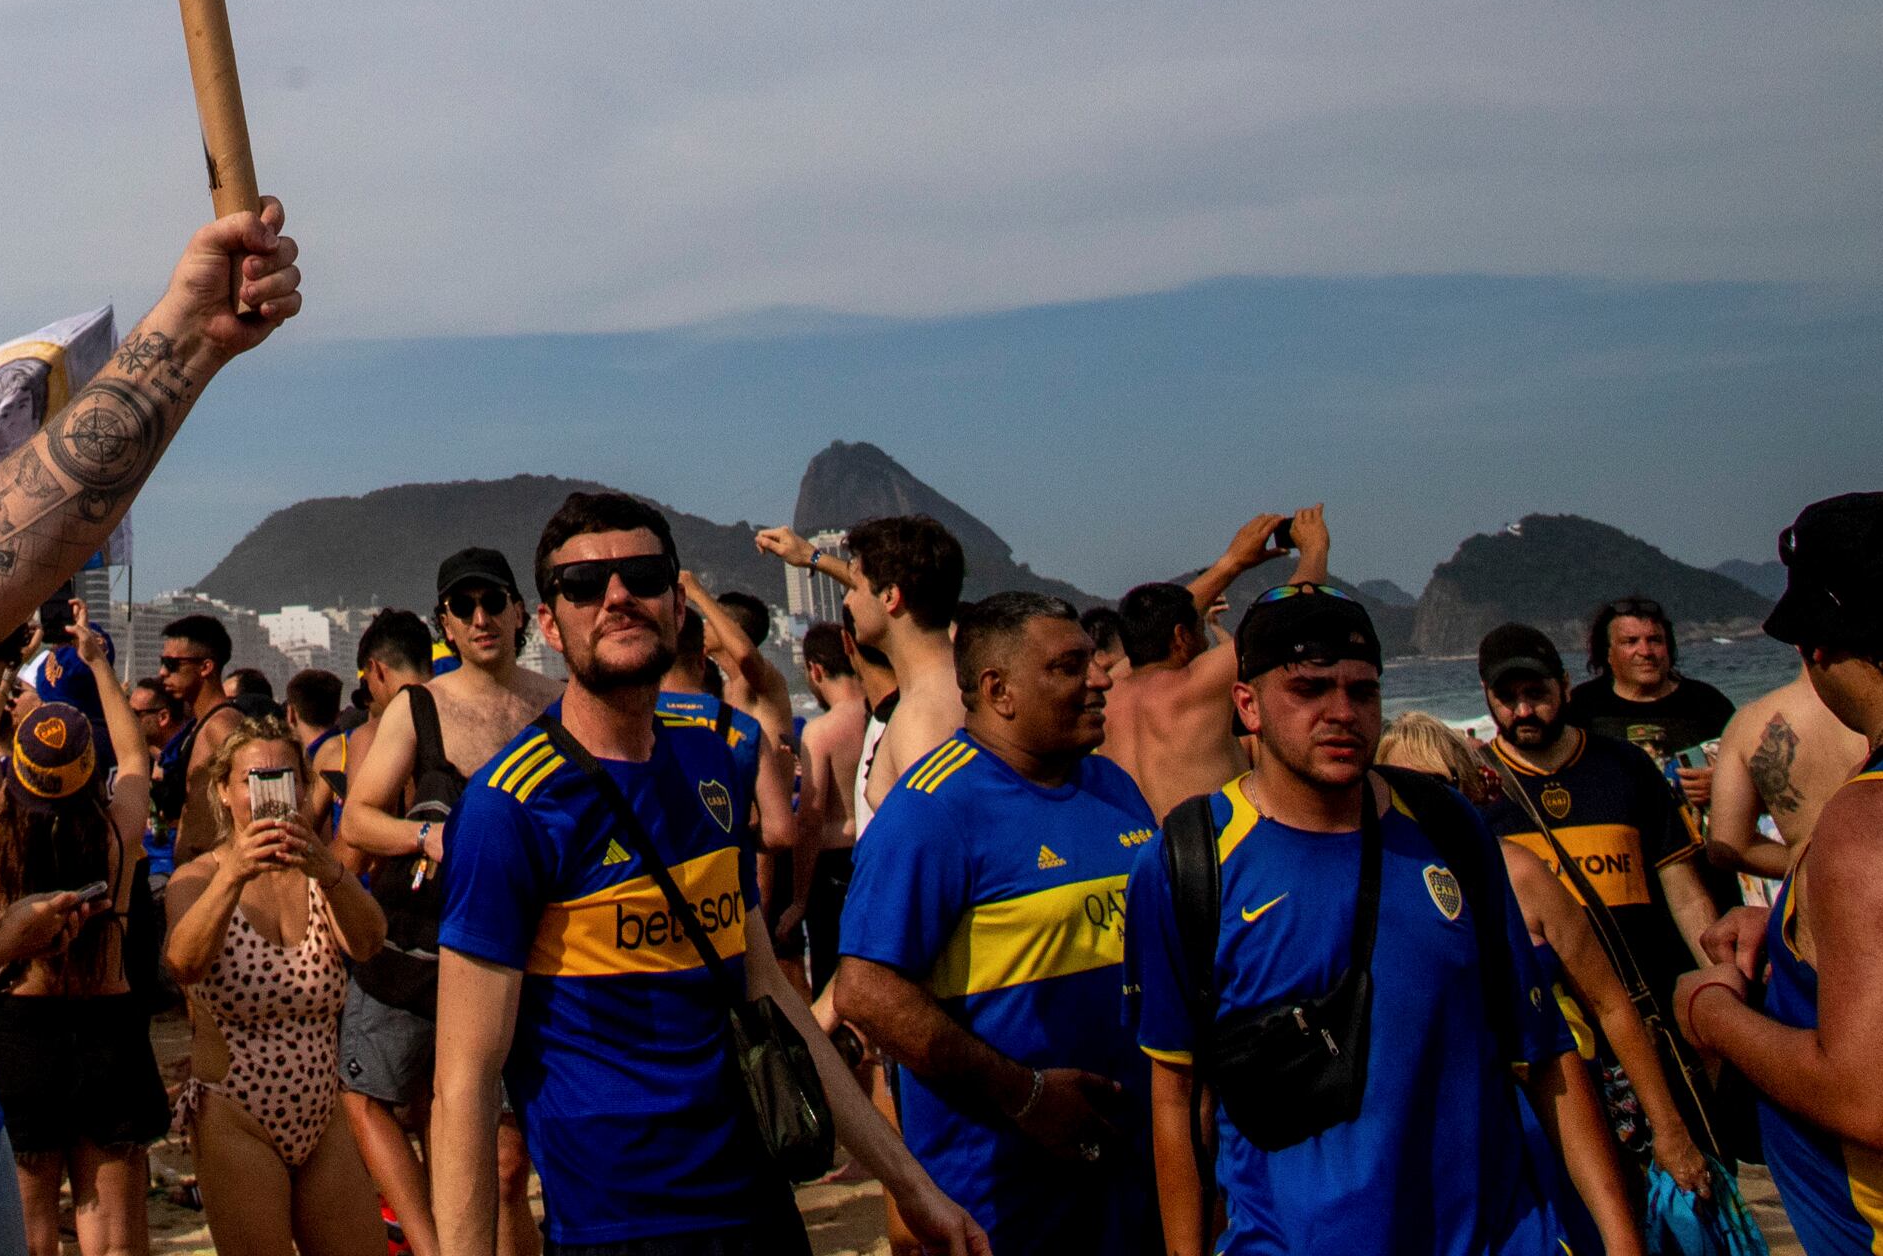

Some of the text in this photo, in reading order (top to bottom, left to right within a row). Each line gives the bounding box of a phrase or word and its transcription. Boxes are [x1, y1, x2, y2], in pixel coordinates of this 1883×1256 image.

[1556, 852, 1632, 875] TONE
[616, 891, 741, 950] betso
[1084, 888, 1128, 931] QAT
